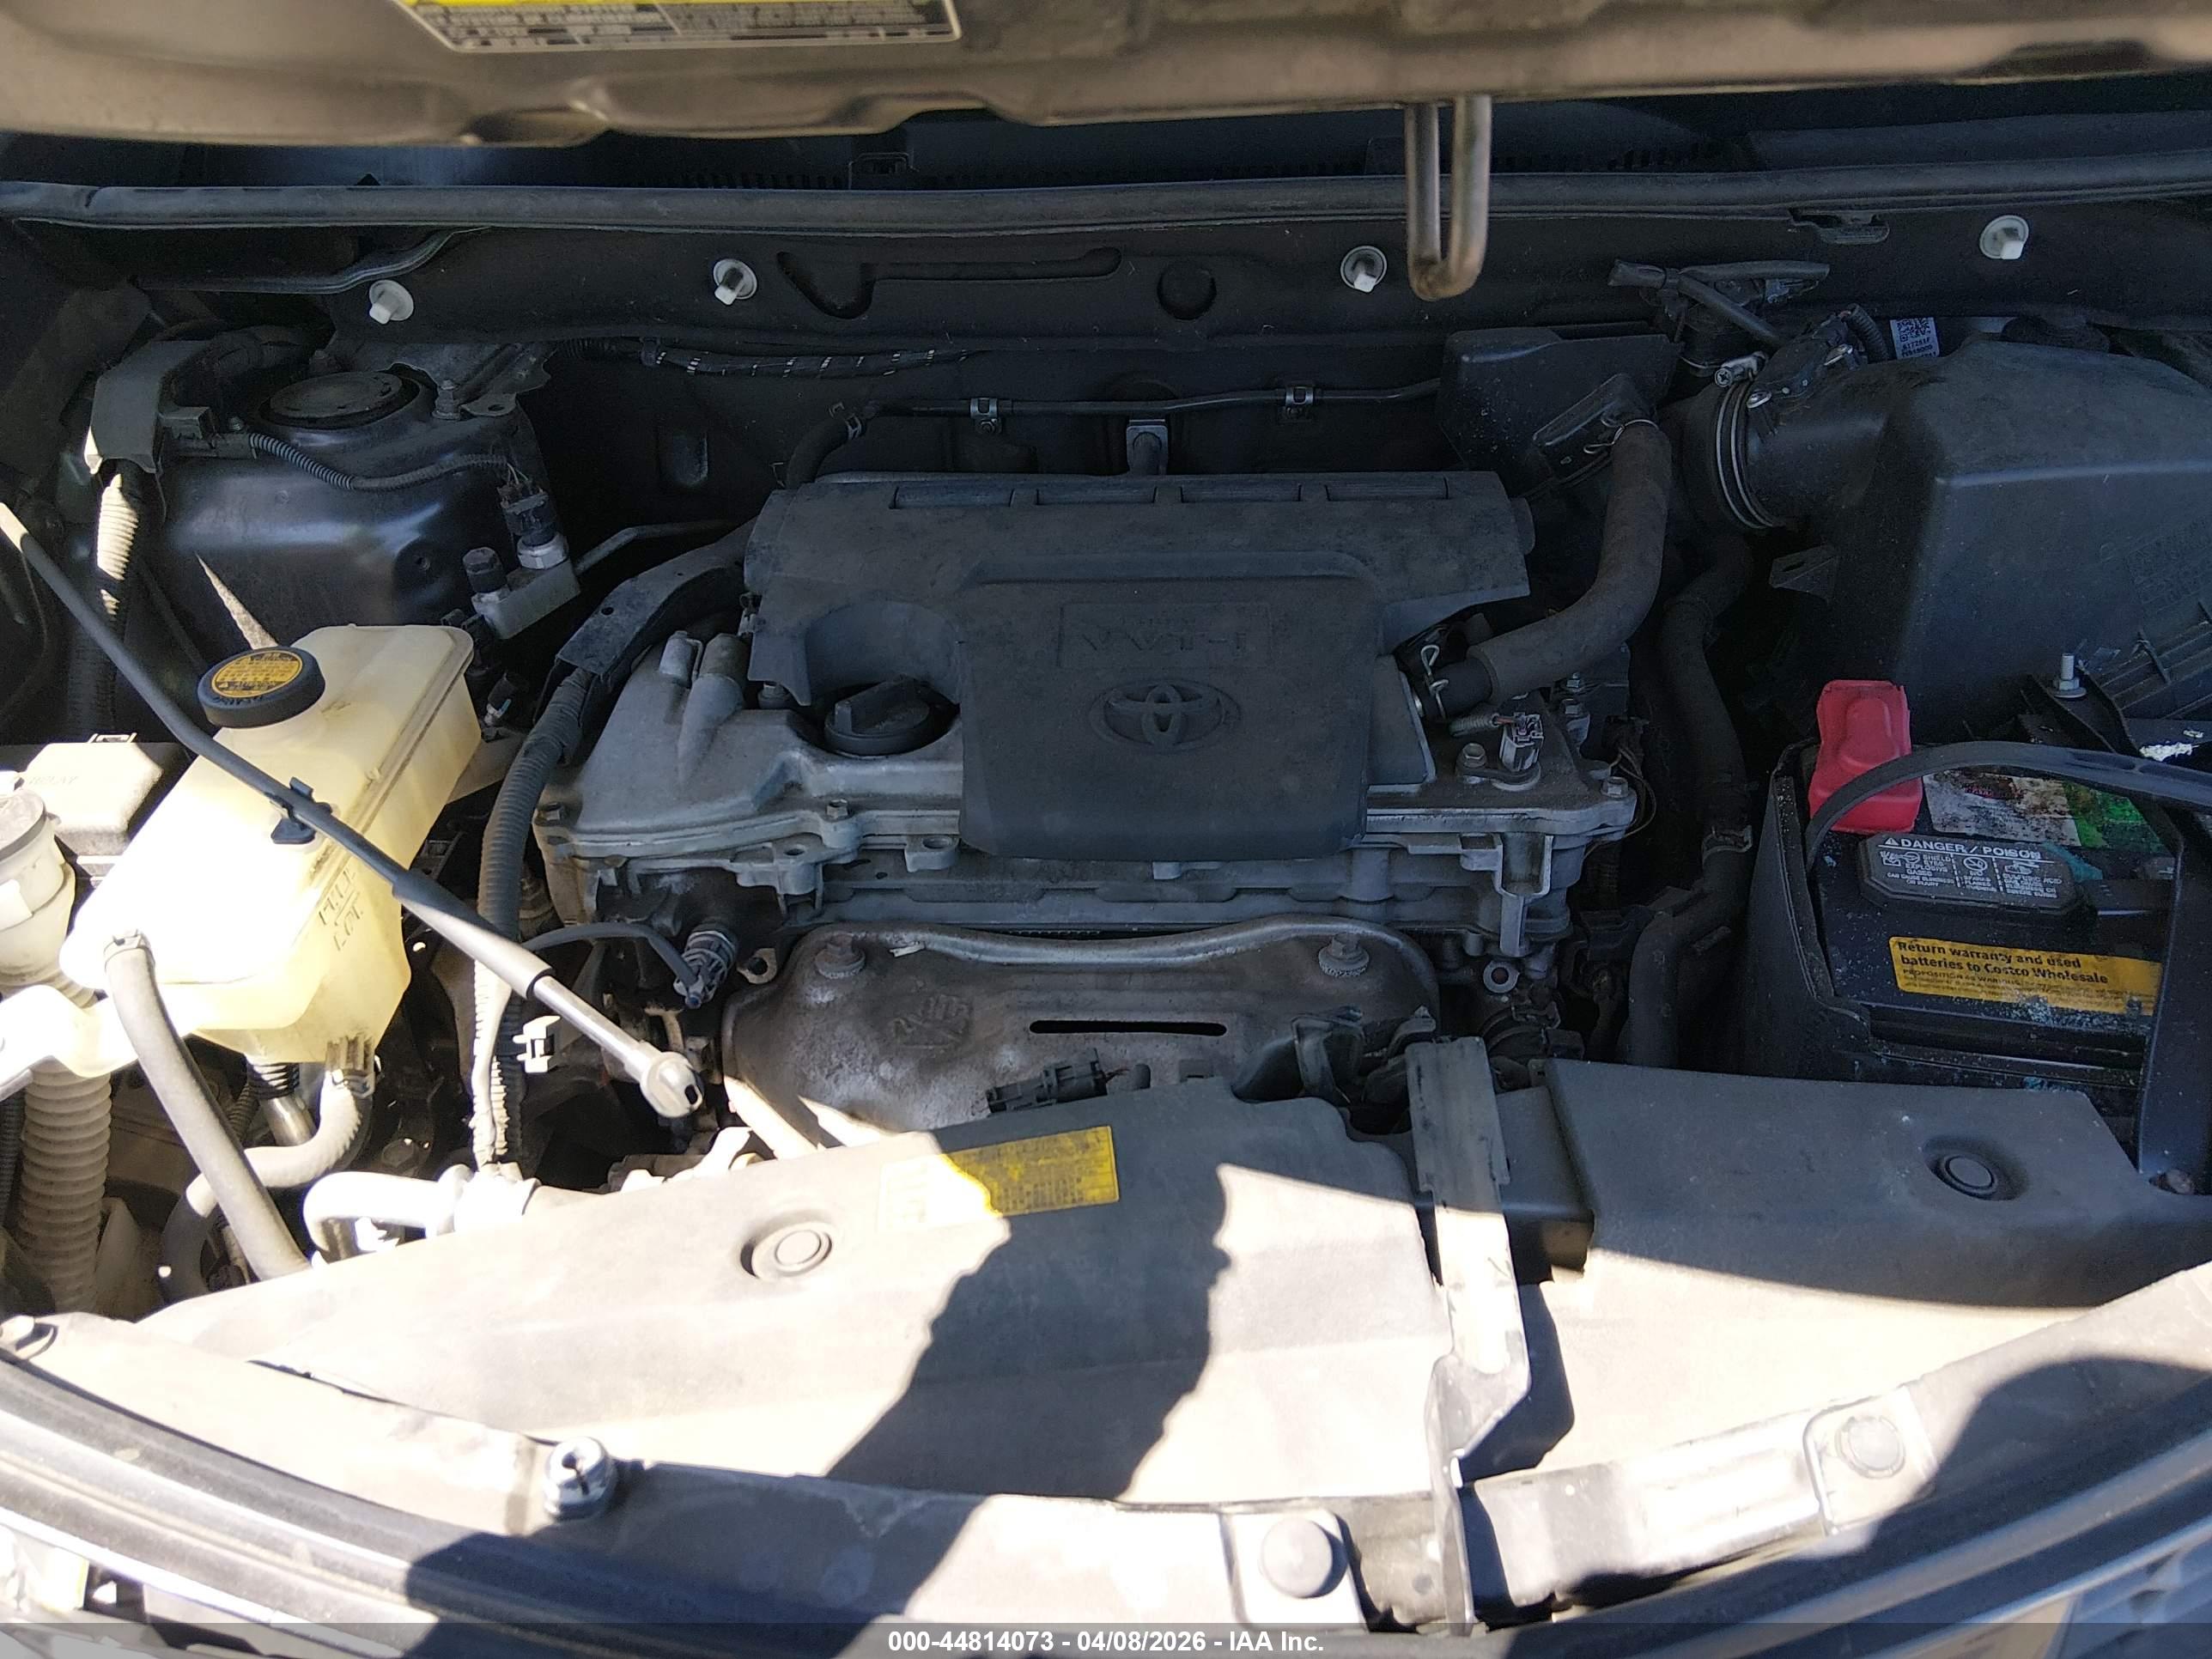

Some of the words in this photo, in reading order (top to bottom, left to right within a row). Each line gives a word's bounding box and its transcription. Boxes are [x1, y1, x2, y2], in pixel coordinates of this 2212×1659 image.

[1900, 838, 1966, 853] DANGER
[1982, 847, 2042, 860] POISON
[1905, 863, 1948, 872] EXPLOSIVE
[1898, 941, 1946, 954] Return
[1949, 948, 2012, 963] warranty
[2016, 954, 2043, 965] and
[2046, 957, 2081, 969] used
[1901, 954, 1964, 970] batteries
[1966, 962, 1981, 972] to
[1984, 963, 2030, 977] Costco
[2031, 967, 2109, 984] Wholesale
